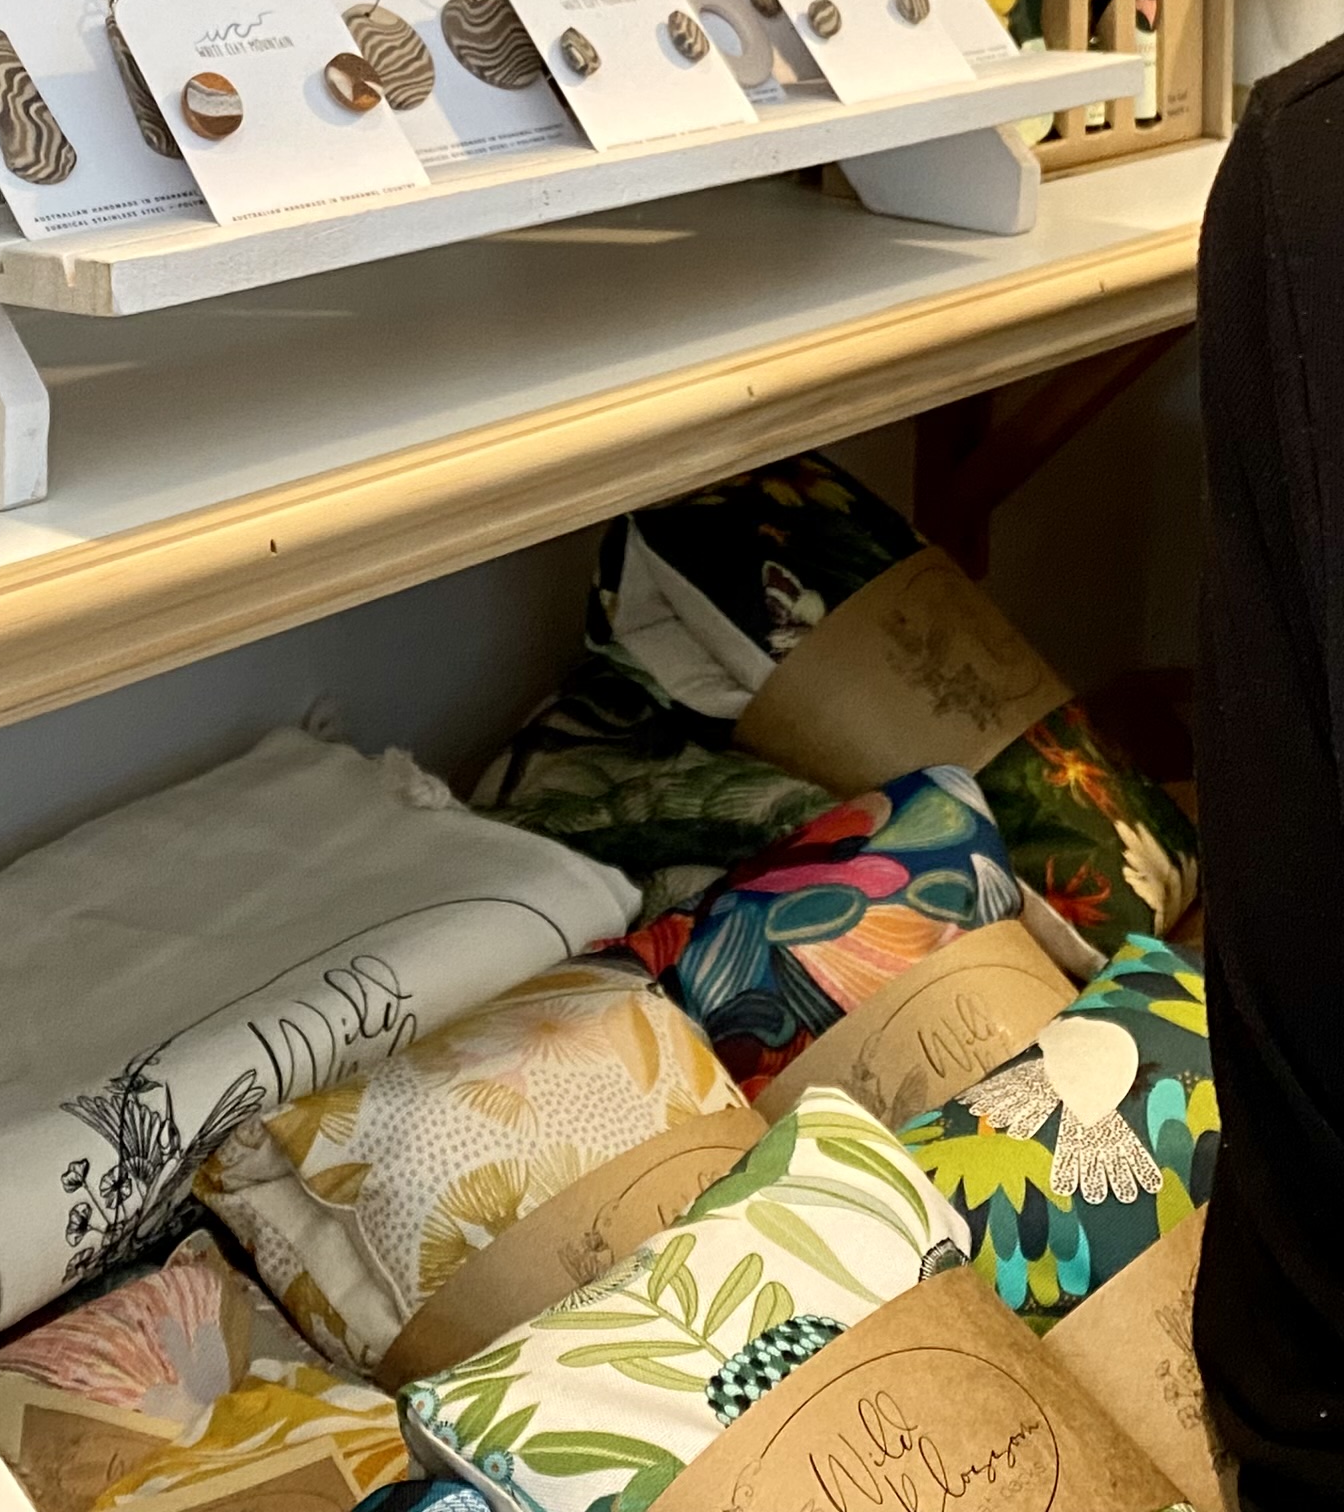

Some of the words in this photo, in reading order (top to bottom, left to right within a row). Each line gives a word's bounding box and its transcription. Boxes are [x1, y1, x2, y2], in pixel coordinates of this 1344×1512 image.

[195, 44, 224, 58] WHITE
[247, 36, 295, 52] MOUNTAIN
[809, 1390, 919, 1512] Wild
